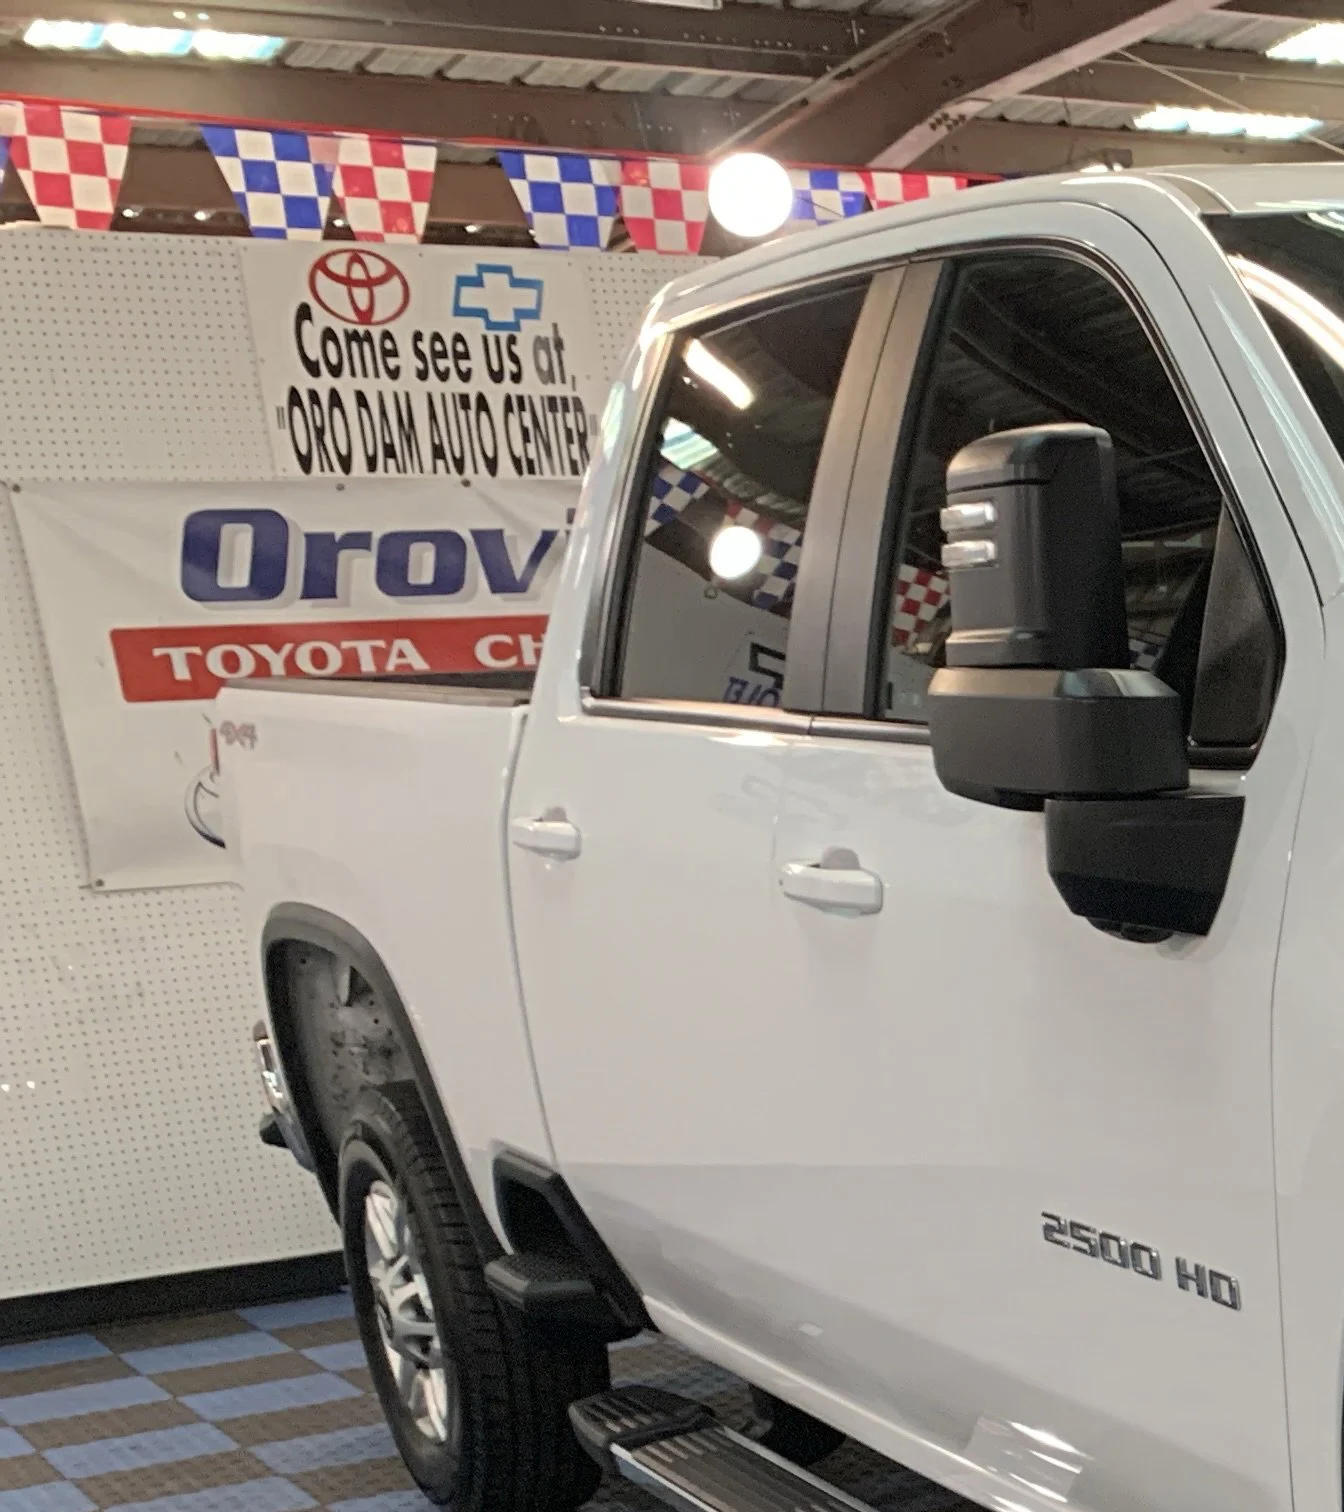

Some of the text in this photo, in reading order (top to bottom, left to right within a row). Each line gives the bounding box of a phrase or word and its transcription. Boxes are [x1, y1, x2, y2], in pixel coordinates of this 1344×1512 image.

[294, 301, 401, 381] Come
[412, 330, 472, 383] see
[481, 333, 522, 384] us
[355, 388, 423, 475] DAM
[427, 391, 498, 476] AUTO
[152, 638, 431, 681] TOYOTA
[1041, 1211, 1241, 1311] 2500 HD
